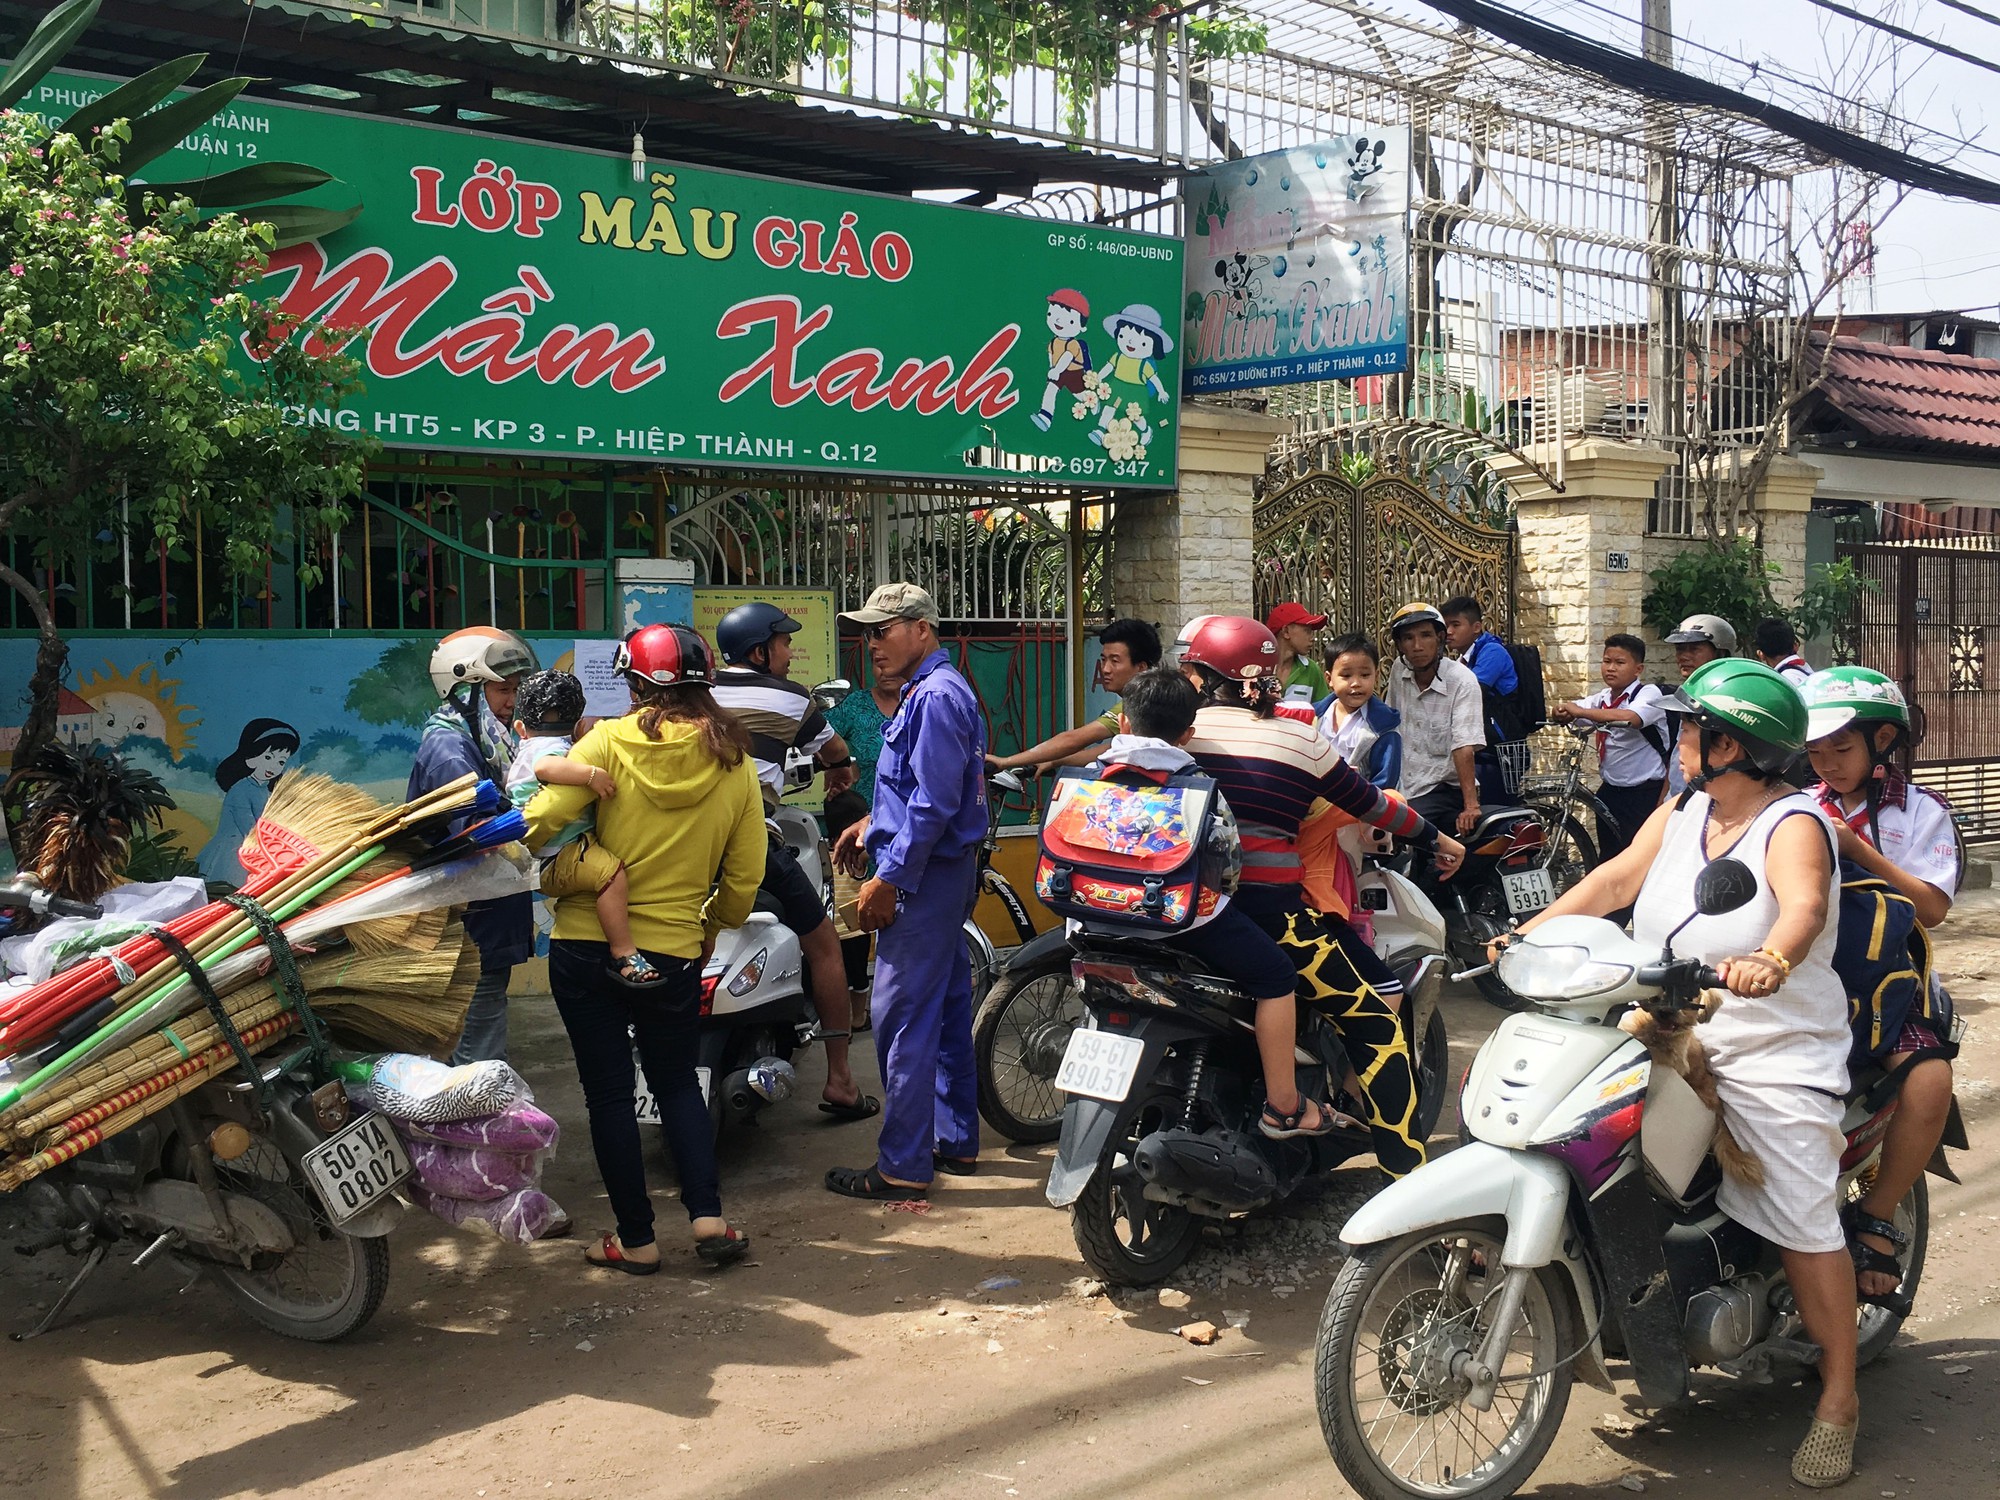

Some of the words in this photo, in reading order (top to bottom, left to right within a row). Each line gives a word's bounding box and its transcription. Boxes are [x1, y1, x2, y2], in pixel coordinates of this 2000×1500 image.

[204, 110, 269, 133] HÀNH
[236, 142, 257, 159] 12
[410, 158, 562, 238] LỚP
[579, 171, 740, 260] MẪU
[753, 212, 913, 282] GIÁO
[1047, 233, 1066, 247] GP
[1069, 233, 1086, 250] SỐ
[1096, 240, 1174, 261] 446/QĐ-UBND
[1288, 268, 1397, 355] Xanh
[233, 238, 666, 394] Mầm
[715, 294, 1020, 419] Xanh
[1192, 375, 1207, 387] ĐC:
[1209, 370, 1236, 385] 65N/2
[1238, 366, 1268, 382] ĐƯỜNG
[1270, 364, 1288, 378] HT5
[1297, 364, 1305, 375] P.
[1308, 361, 1330, 374] HIỆP
[1333, 355, 1365, 371] THÀNH
[1374, 351, 1397, 367] Q.12
[375, 411, 439, 436] HT5
[473, 418, 518, 440] KP
[528, 422, 545, 443] 3
[577, 425, 604, 447] P.
[616, 426, 685, 455] HIỆP
[695, 431, 793, 458] THÀNH
[820, 440, 877, 463] Q.12
[1070, 456, 1107, 475] 697
[1113, 459, 1150, 477] 347
[1933, 844, 1953, 856] NTB
[1510, 873, 1543, 893] 52-F1
[1514, 890, 1549, 910] 5932
[1078, 1036, 1128, 1067] 59-G1
[1063, 1061, 1126, 1095] 990.51
[321, 1121, 388, 1179] 50-YA
[338, 1149, 402, 1208] 0802
